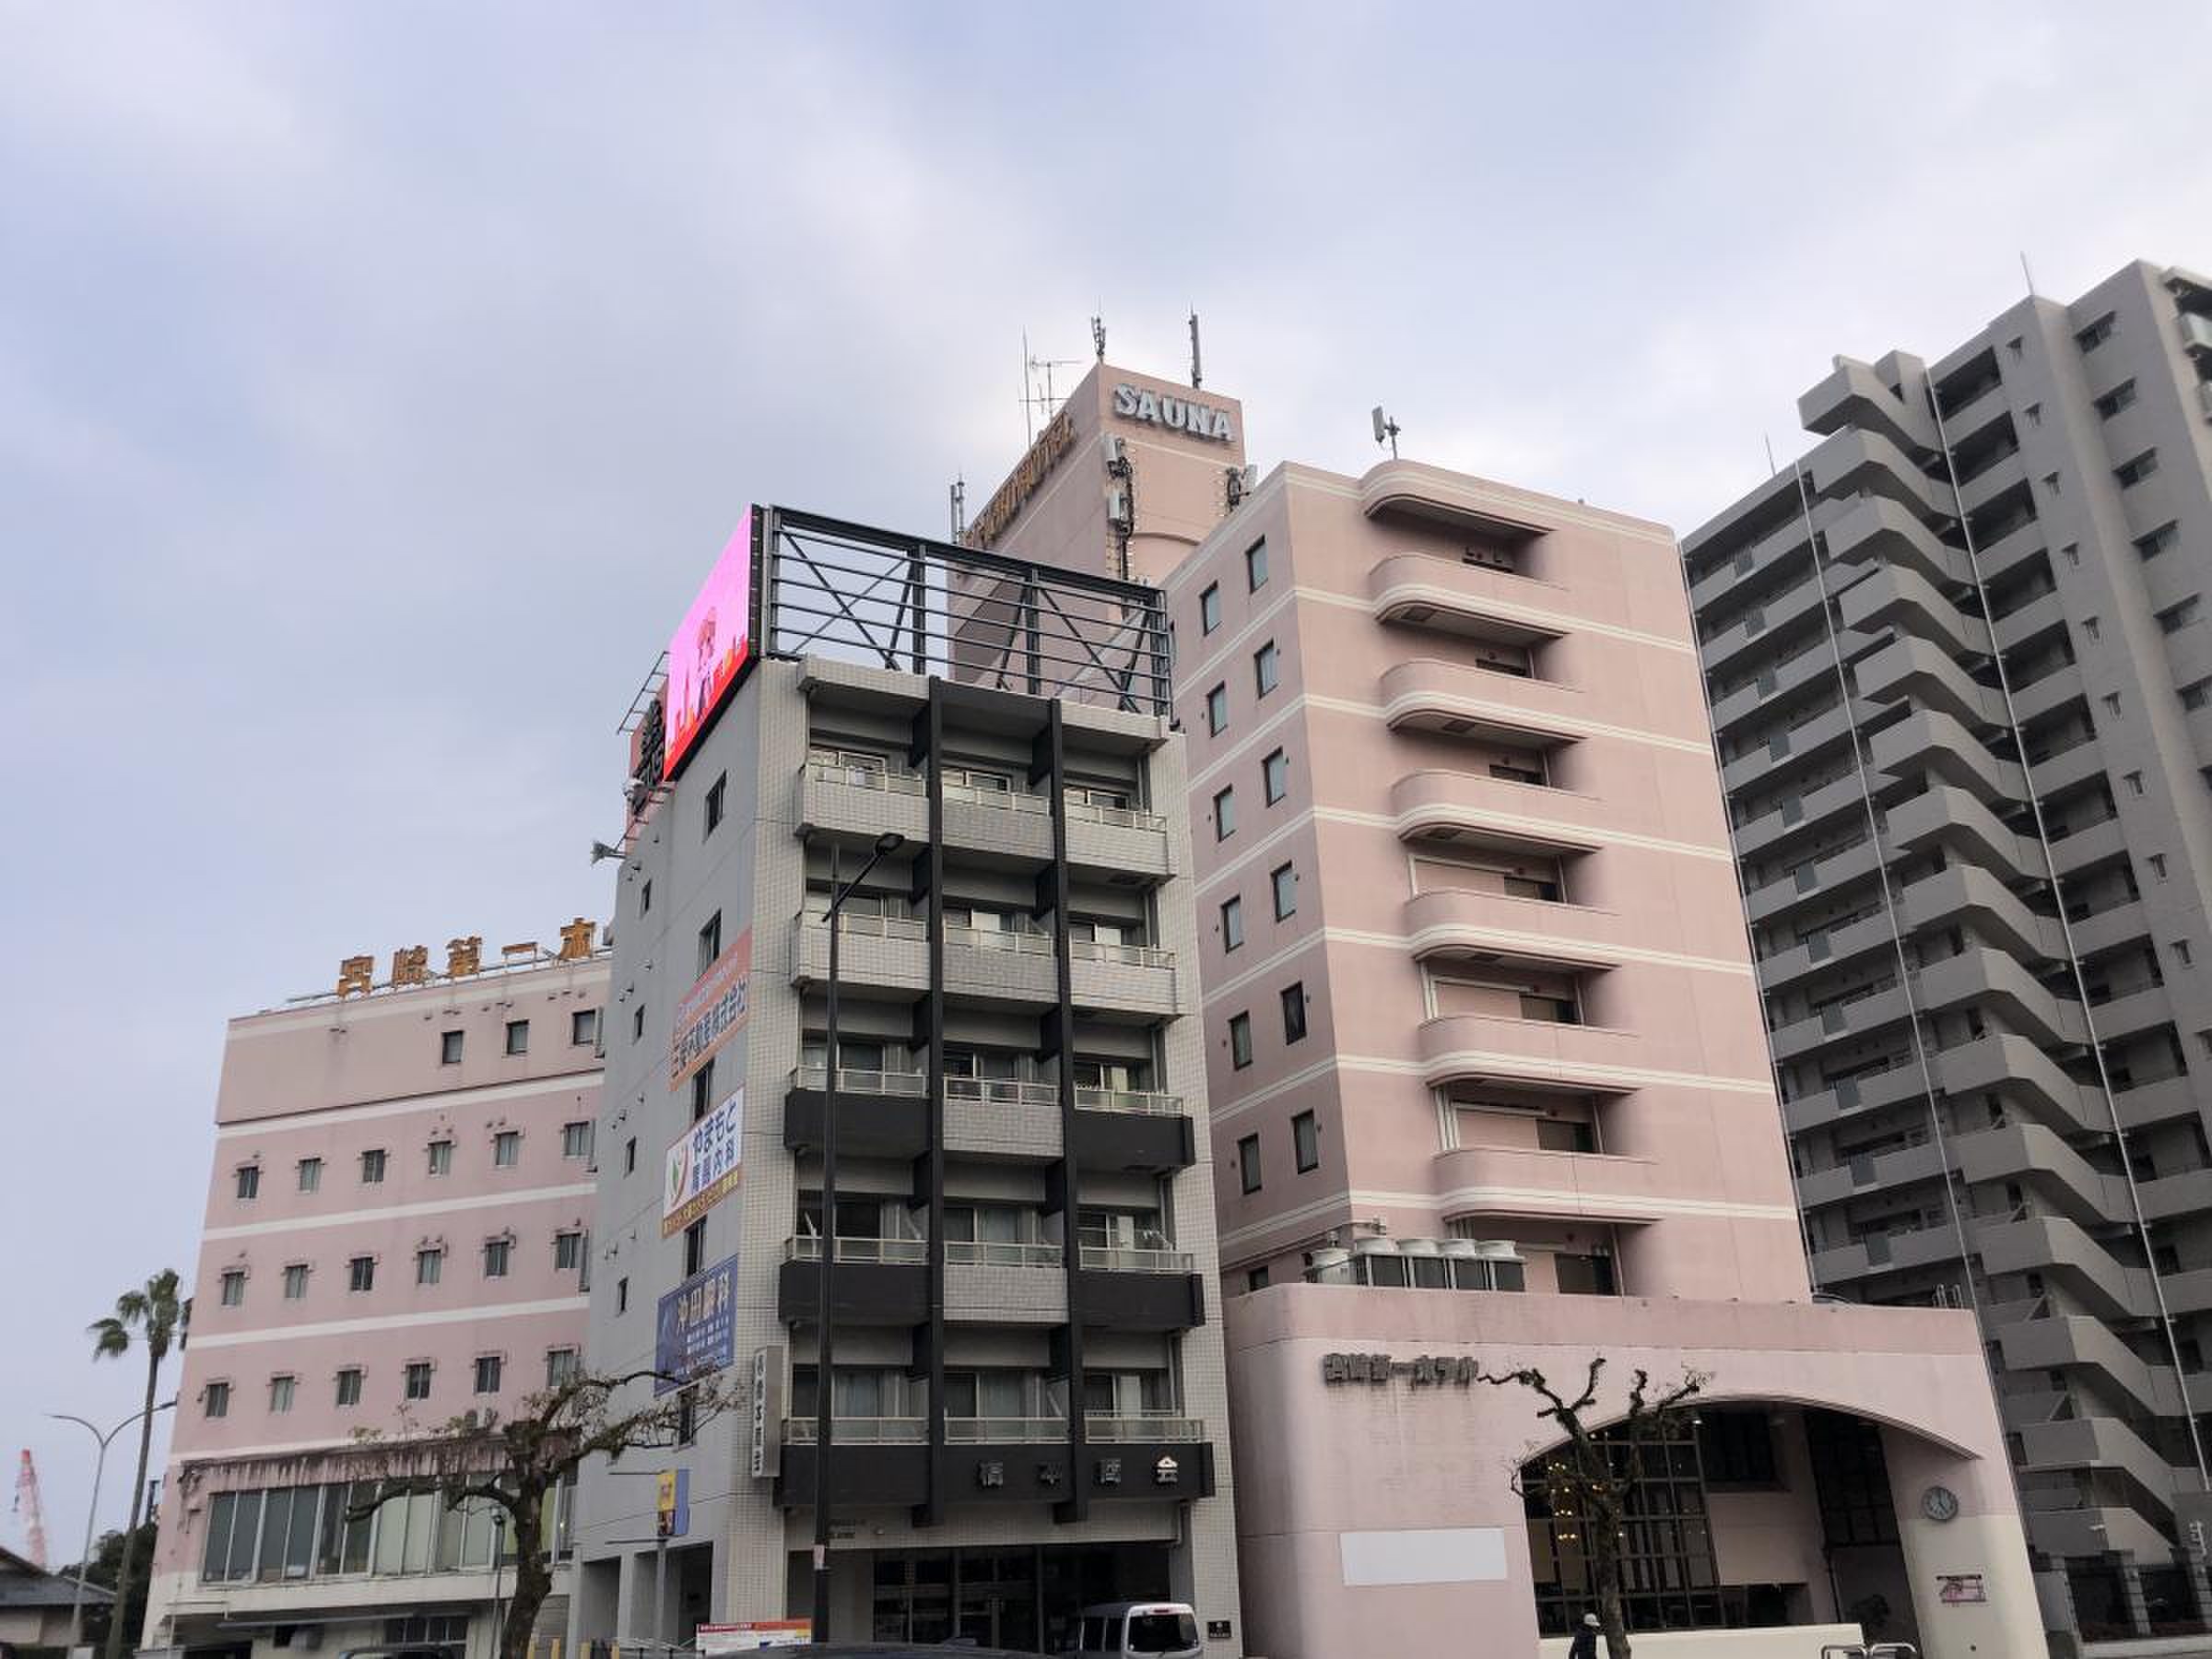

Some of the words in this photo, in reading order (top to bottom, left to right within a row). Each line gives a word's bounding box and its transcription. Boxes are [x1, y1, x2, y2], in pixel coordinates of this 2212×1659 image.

[1114, 383, 1233, 442] SAUNA
[692, 1100, 737, 1163] やまもと
